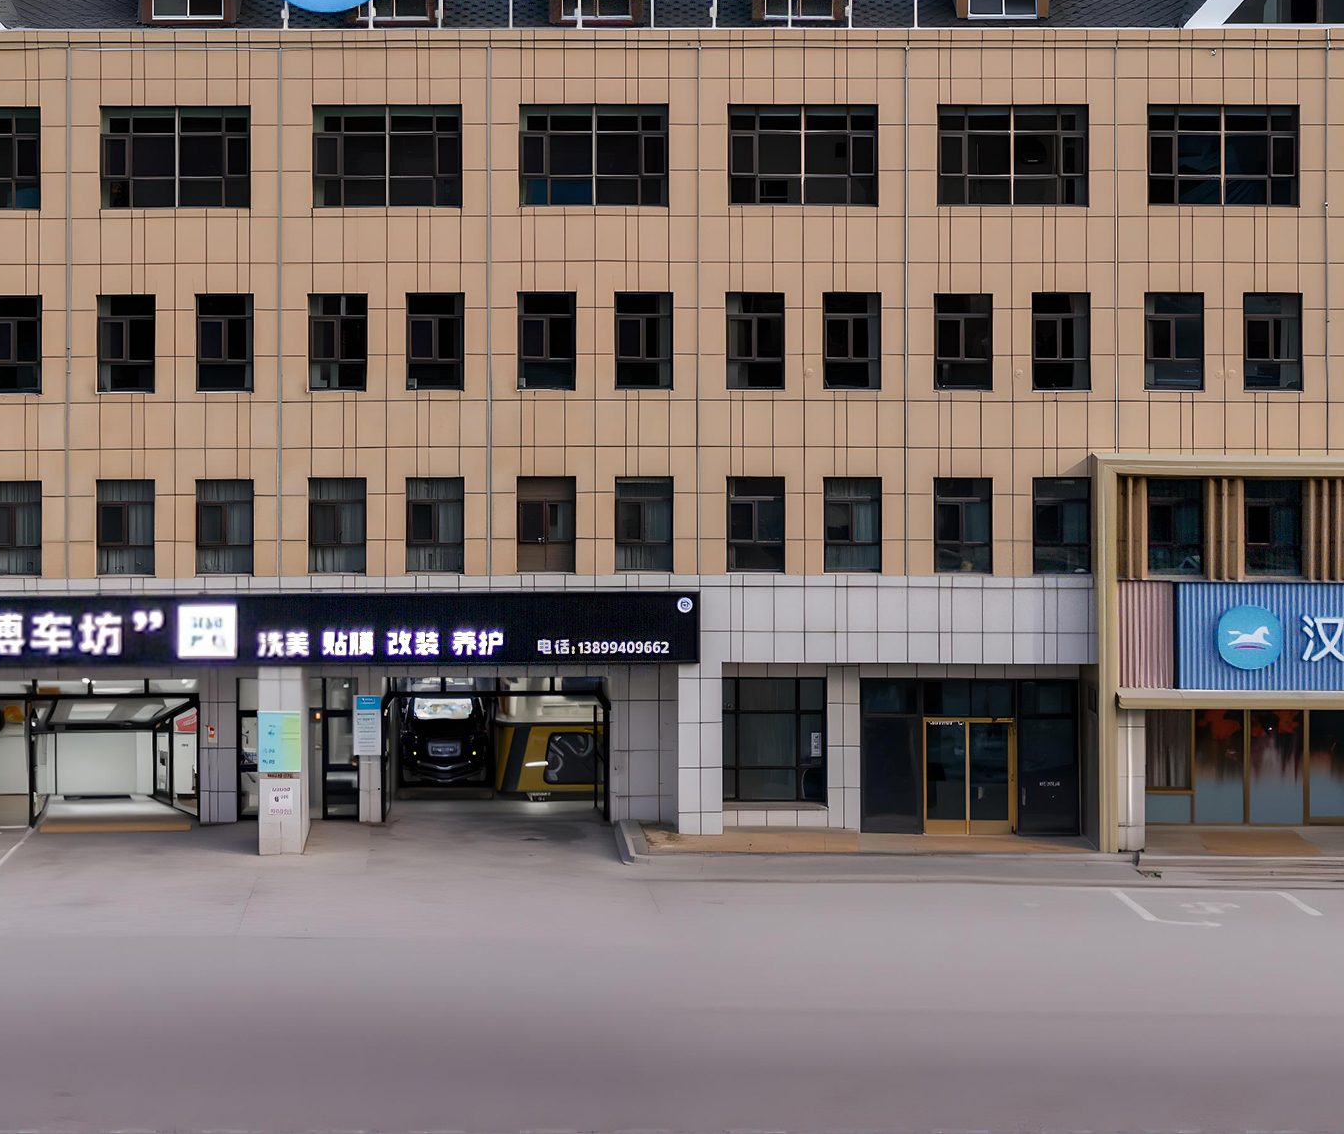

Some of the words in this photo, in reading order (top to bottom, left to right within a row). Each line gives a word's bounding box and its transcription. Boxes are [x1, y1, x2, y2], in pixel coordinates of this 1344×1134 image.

[257, 631, 309, 657] 洗美
[322, 631, 374, 657] 贴膜
[387, 630, 439, 657] 改装
[453, 630, 504, 656] 养护
